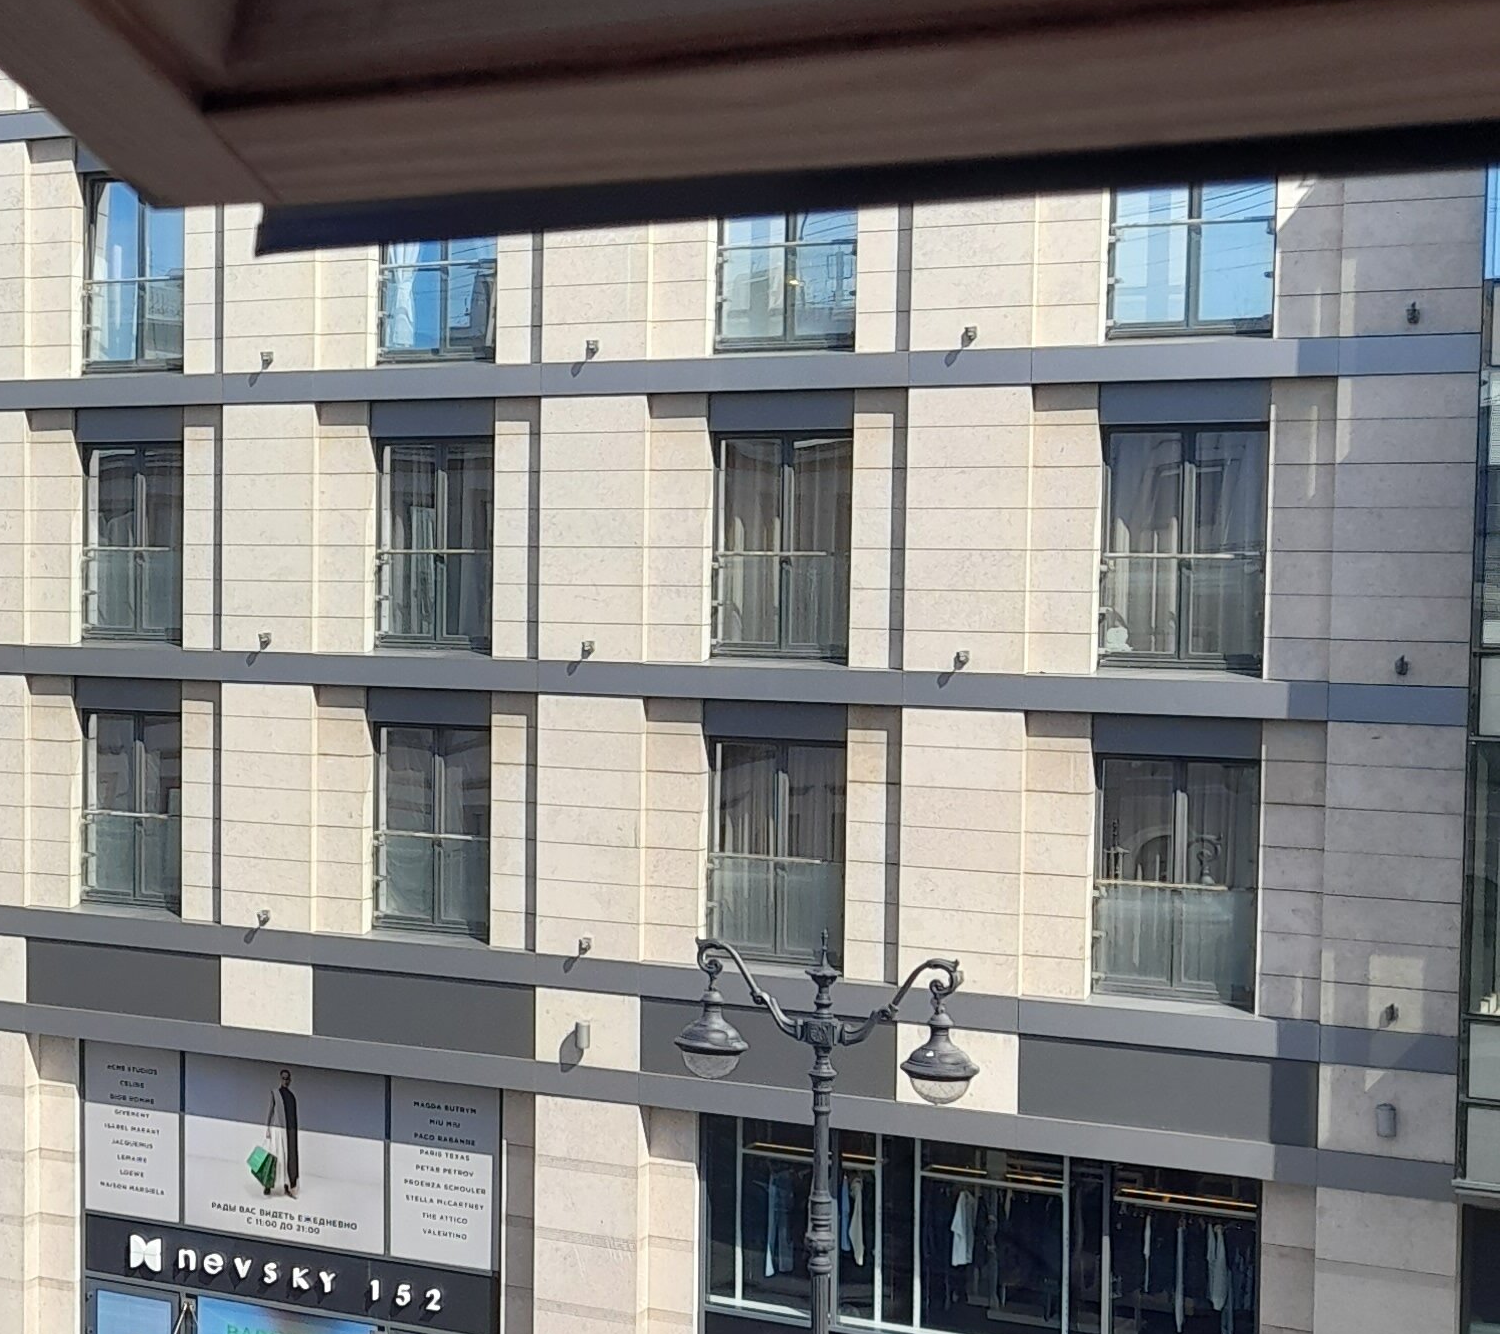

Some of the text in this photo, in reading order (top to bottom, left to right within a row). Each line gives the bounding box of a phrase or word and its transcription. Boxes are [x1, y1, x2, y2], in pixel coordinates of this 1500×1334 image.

[413, 1101, 441, 1111] MAGDA
[413, 1132, 435, 1141] PACO
[443, 1167, 474, 1177] PETROV
[444, 1184, 486, 1195] SCHOULER
[405, 1194, 434, 1204] STELLA
[211, 1201, 358, 1231] РАДЫ ВАС ВИДЕТЬ ЕЖЕДНЕВНО
[422, 1212, 468, 1225] THE ATTICO
[255, 1219, 278, 1228] 11:00
[279, 1223, 293, 1231] ДО
[296, 1225, 321, 1235] 21:00
[368, 1278, 442, 1312] 152
